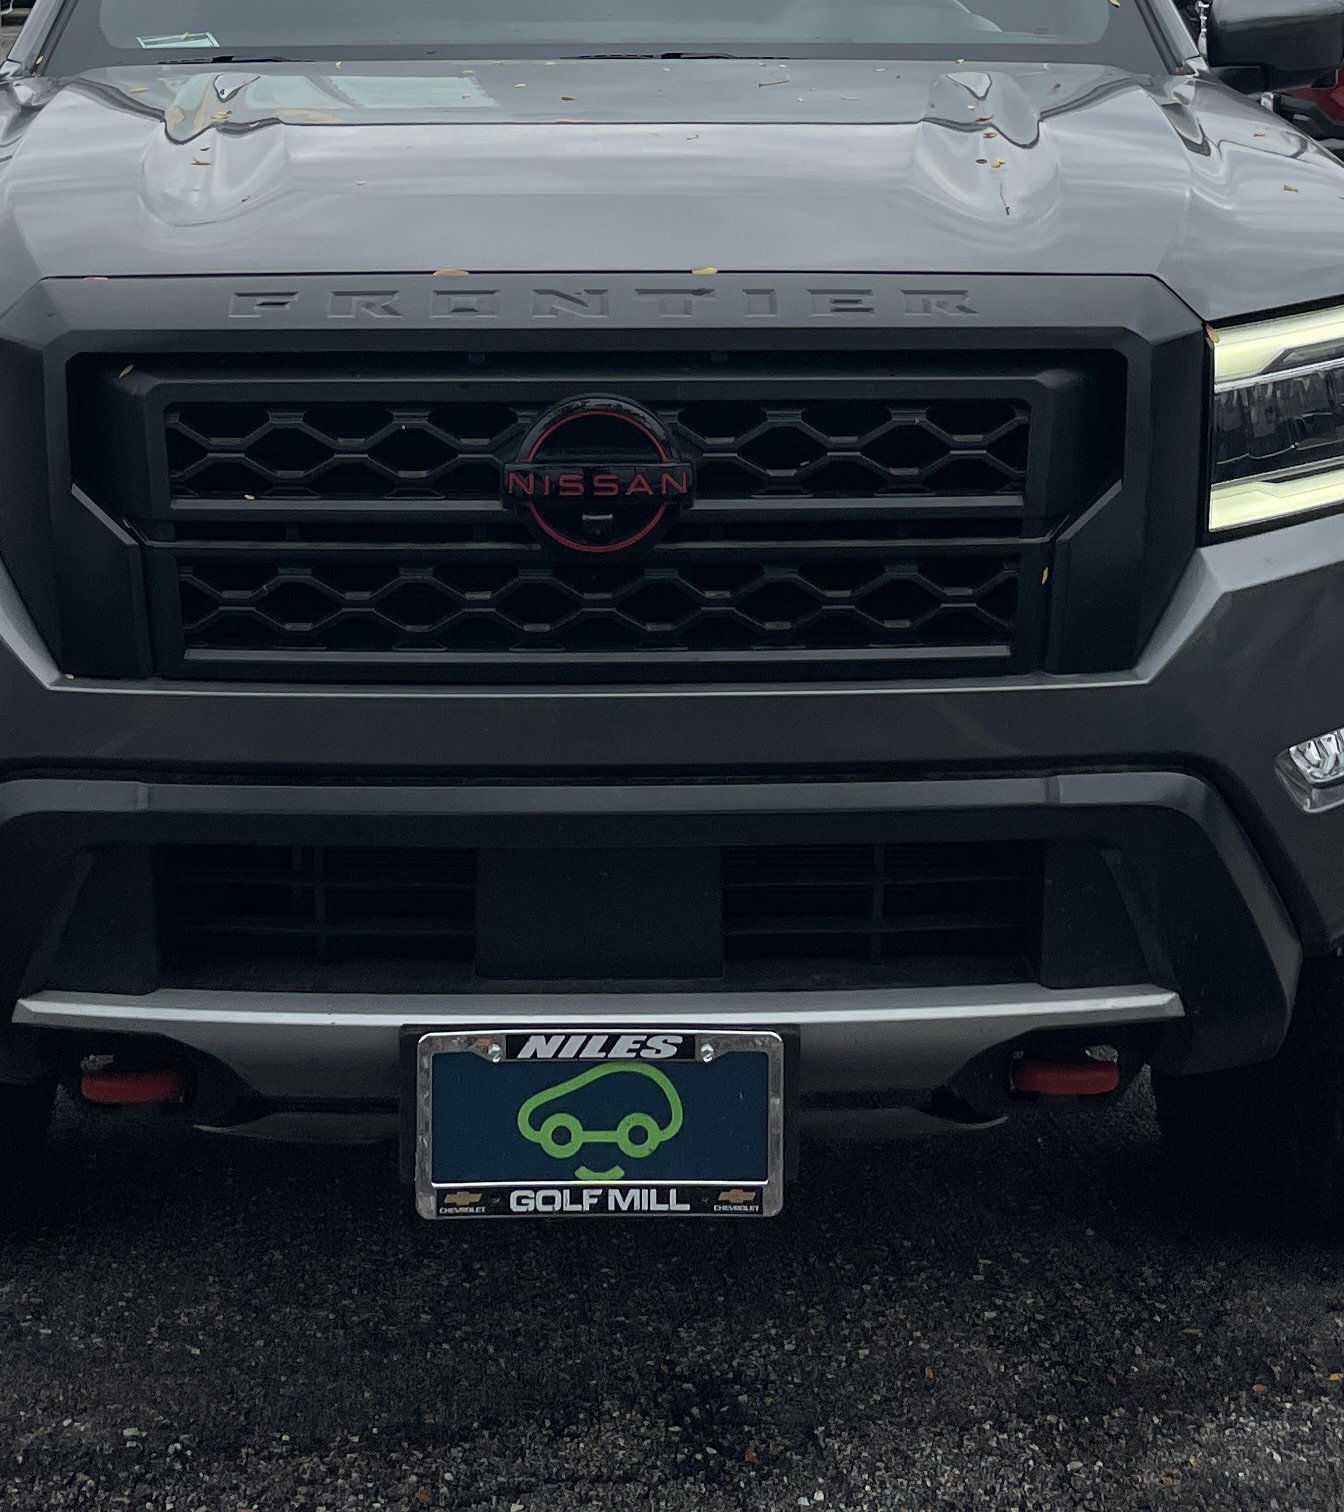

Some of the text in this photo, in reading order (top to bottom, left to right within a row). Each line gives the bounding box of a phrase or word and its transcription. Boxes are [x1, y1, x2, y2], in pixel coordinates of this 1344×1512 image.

[227, 287, 980, 320] FRONTIER
[506, 471, 689, 497] NISSAN
[517, 1034, 684, 1059] NILES
[509, 1188, 691, 1212] GOLF MILL
